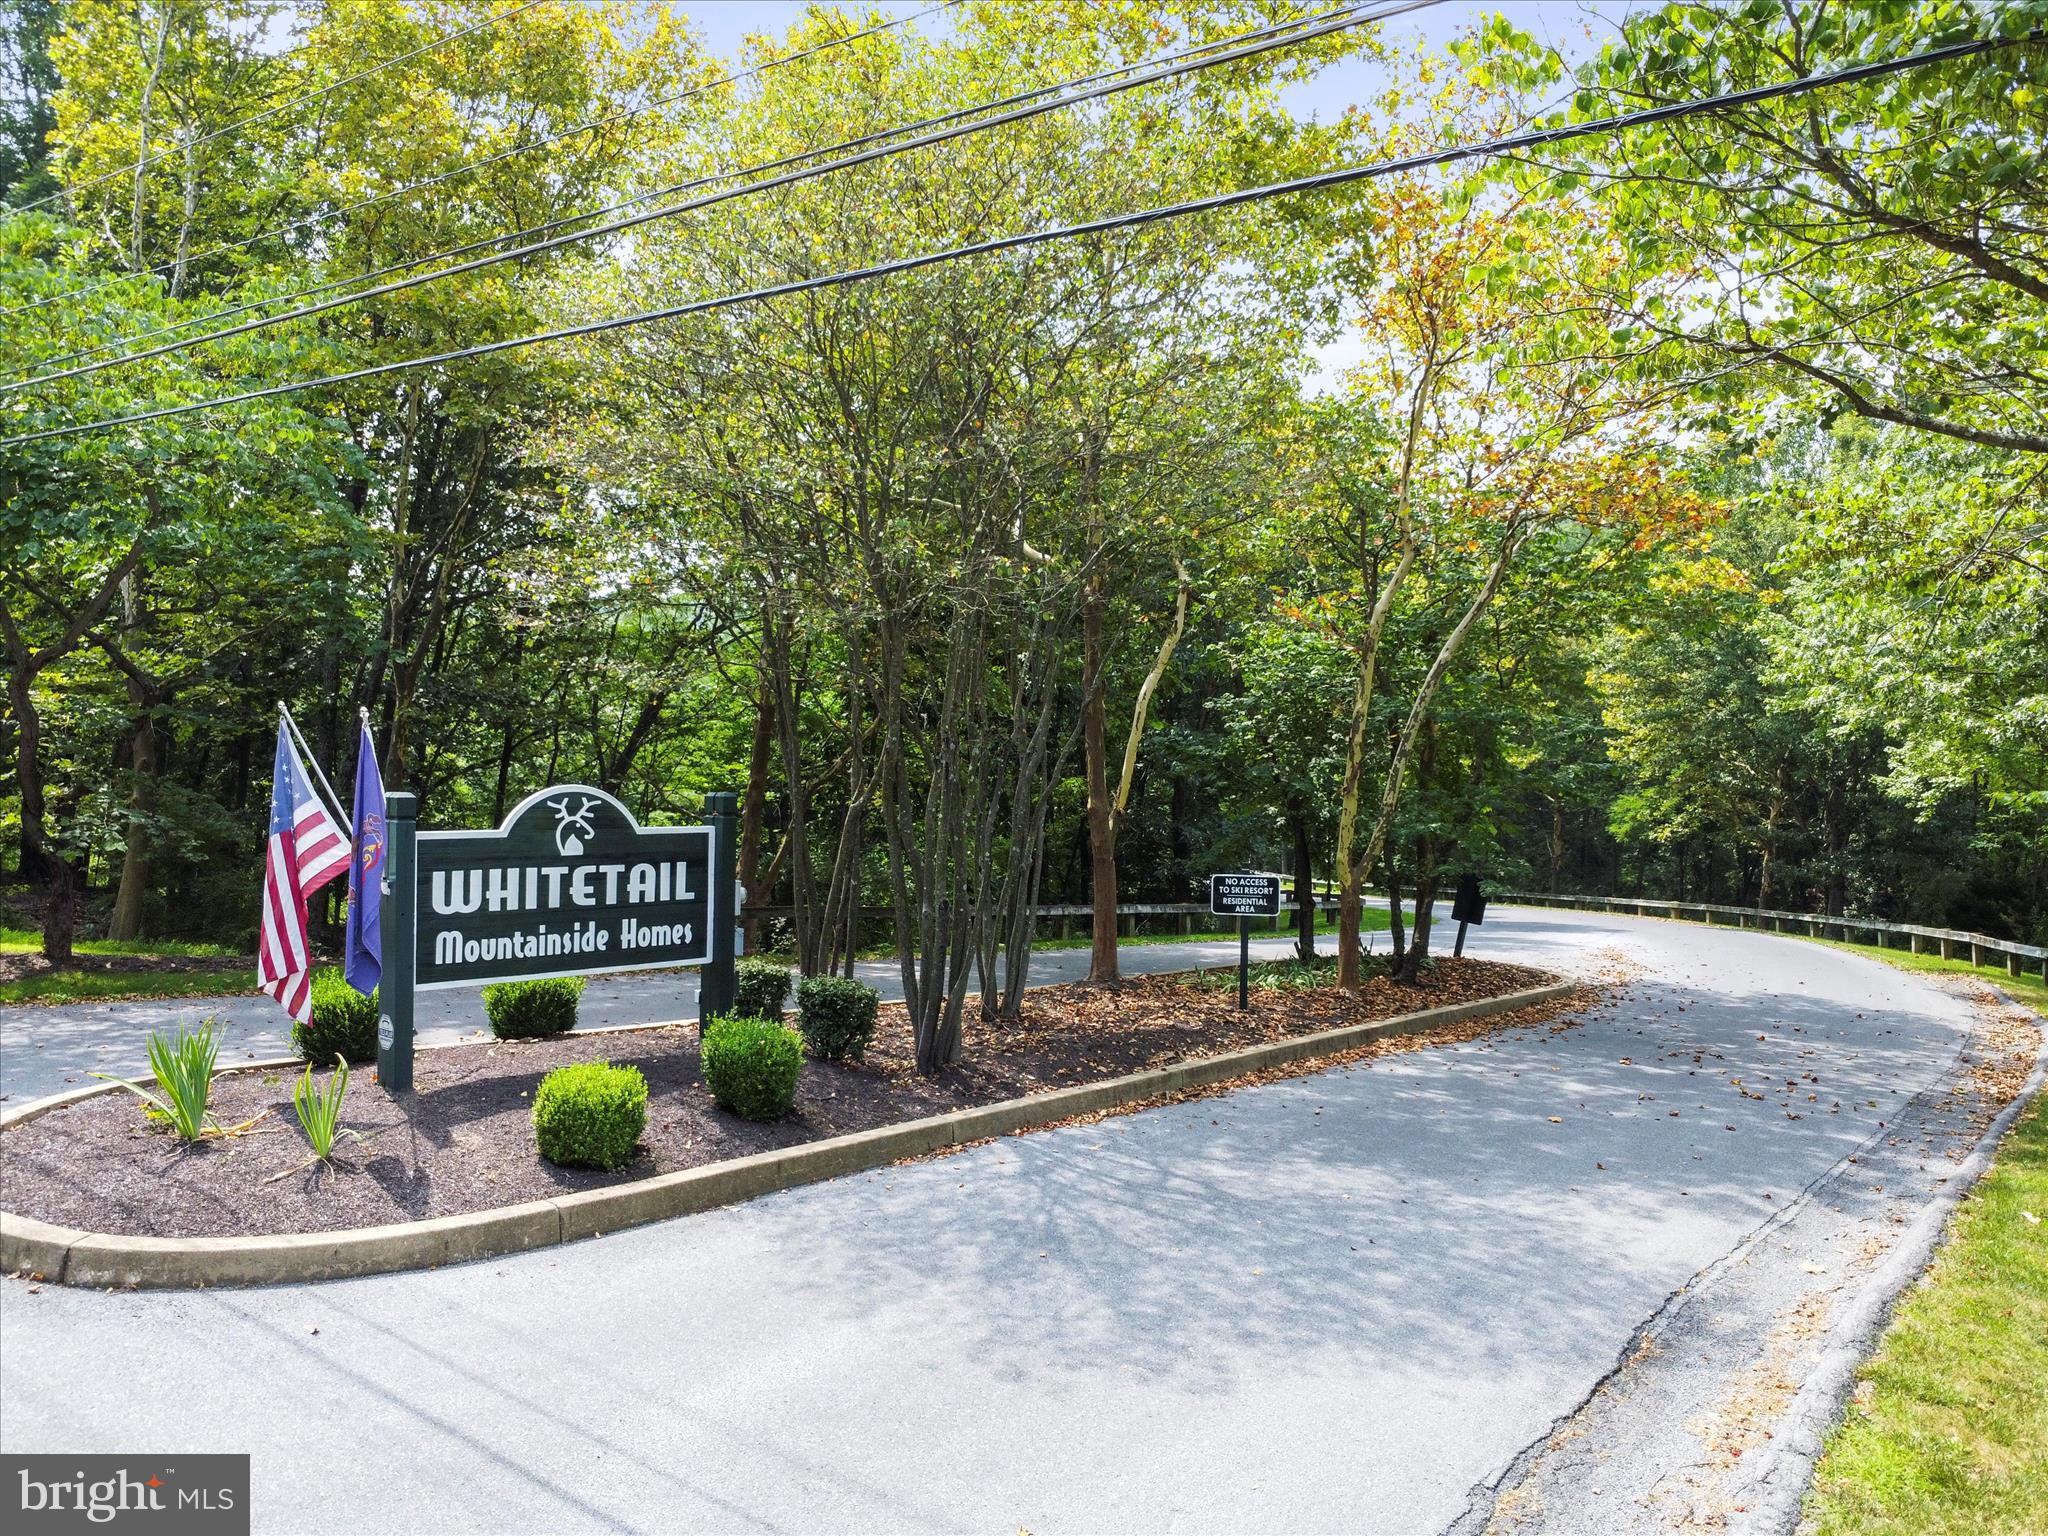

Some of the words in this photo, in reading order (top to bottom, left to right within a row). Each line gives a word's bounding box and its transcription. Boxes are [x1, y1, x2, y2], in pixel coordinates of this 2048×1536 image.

[1239, 878, 1268, 886] ACCESS
[432, 862, 695, 914] WHITETAIL
[1219, 886, 1230, 894] TO
[1231, 886, 1243, 894] SKI
[1223, 897, 1267, 905] RESIDENTIAL
[435, 920, 608, 965] Mountainside
[621, 918, 693, 949] Homes
